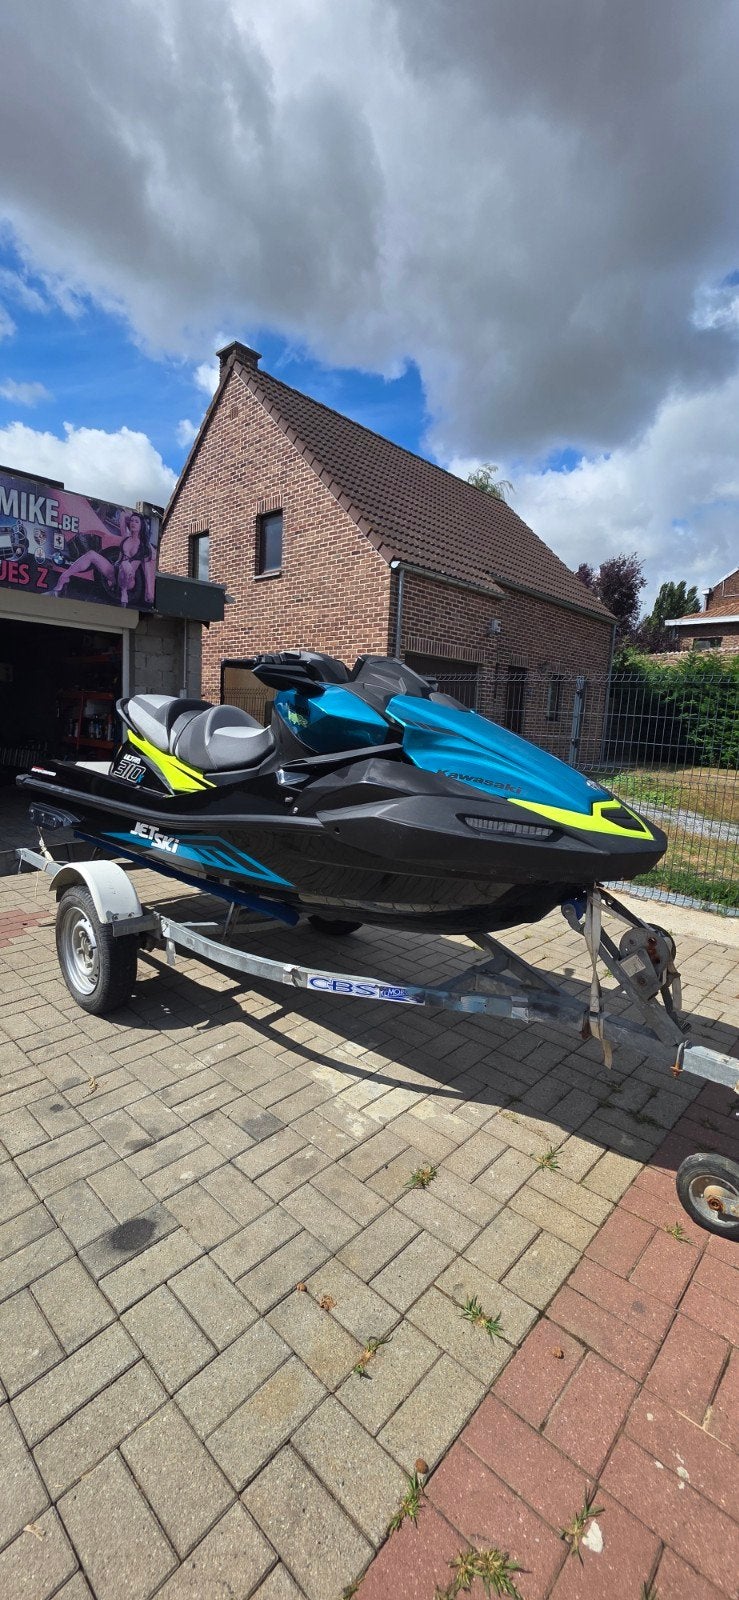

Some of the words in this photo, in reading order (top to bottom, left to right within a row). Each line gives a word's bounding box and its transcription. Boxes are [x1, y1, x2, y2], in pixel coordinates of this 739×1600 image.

[36, 567, 48, 589] Z
[436, 769, 521, 794] Kawasaki
[309, 977, 376, 996] CBS
